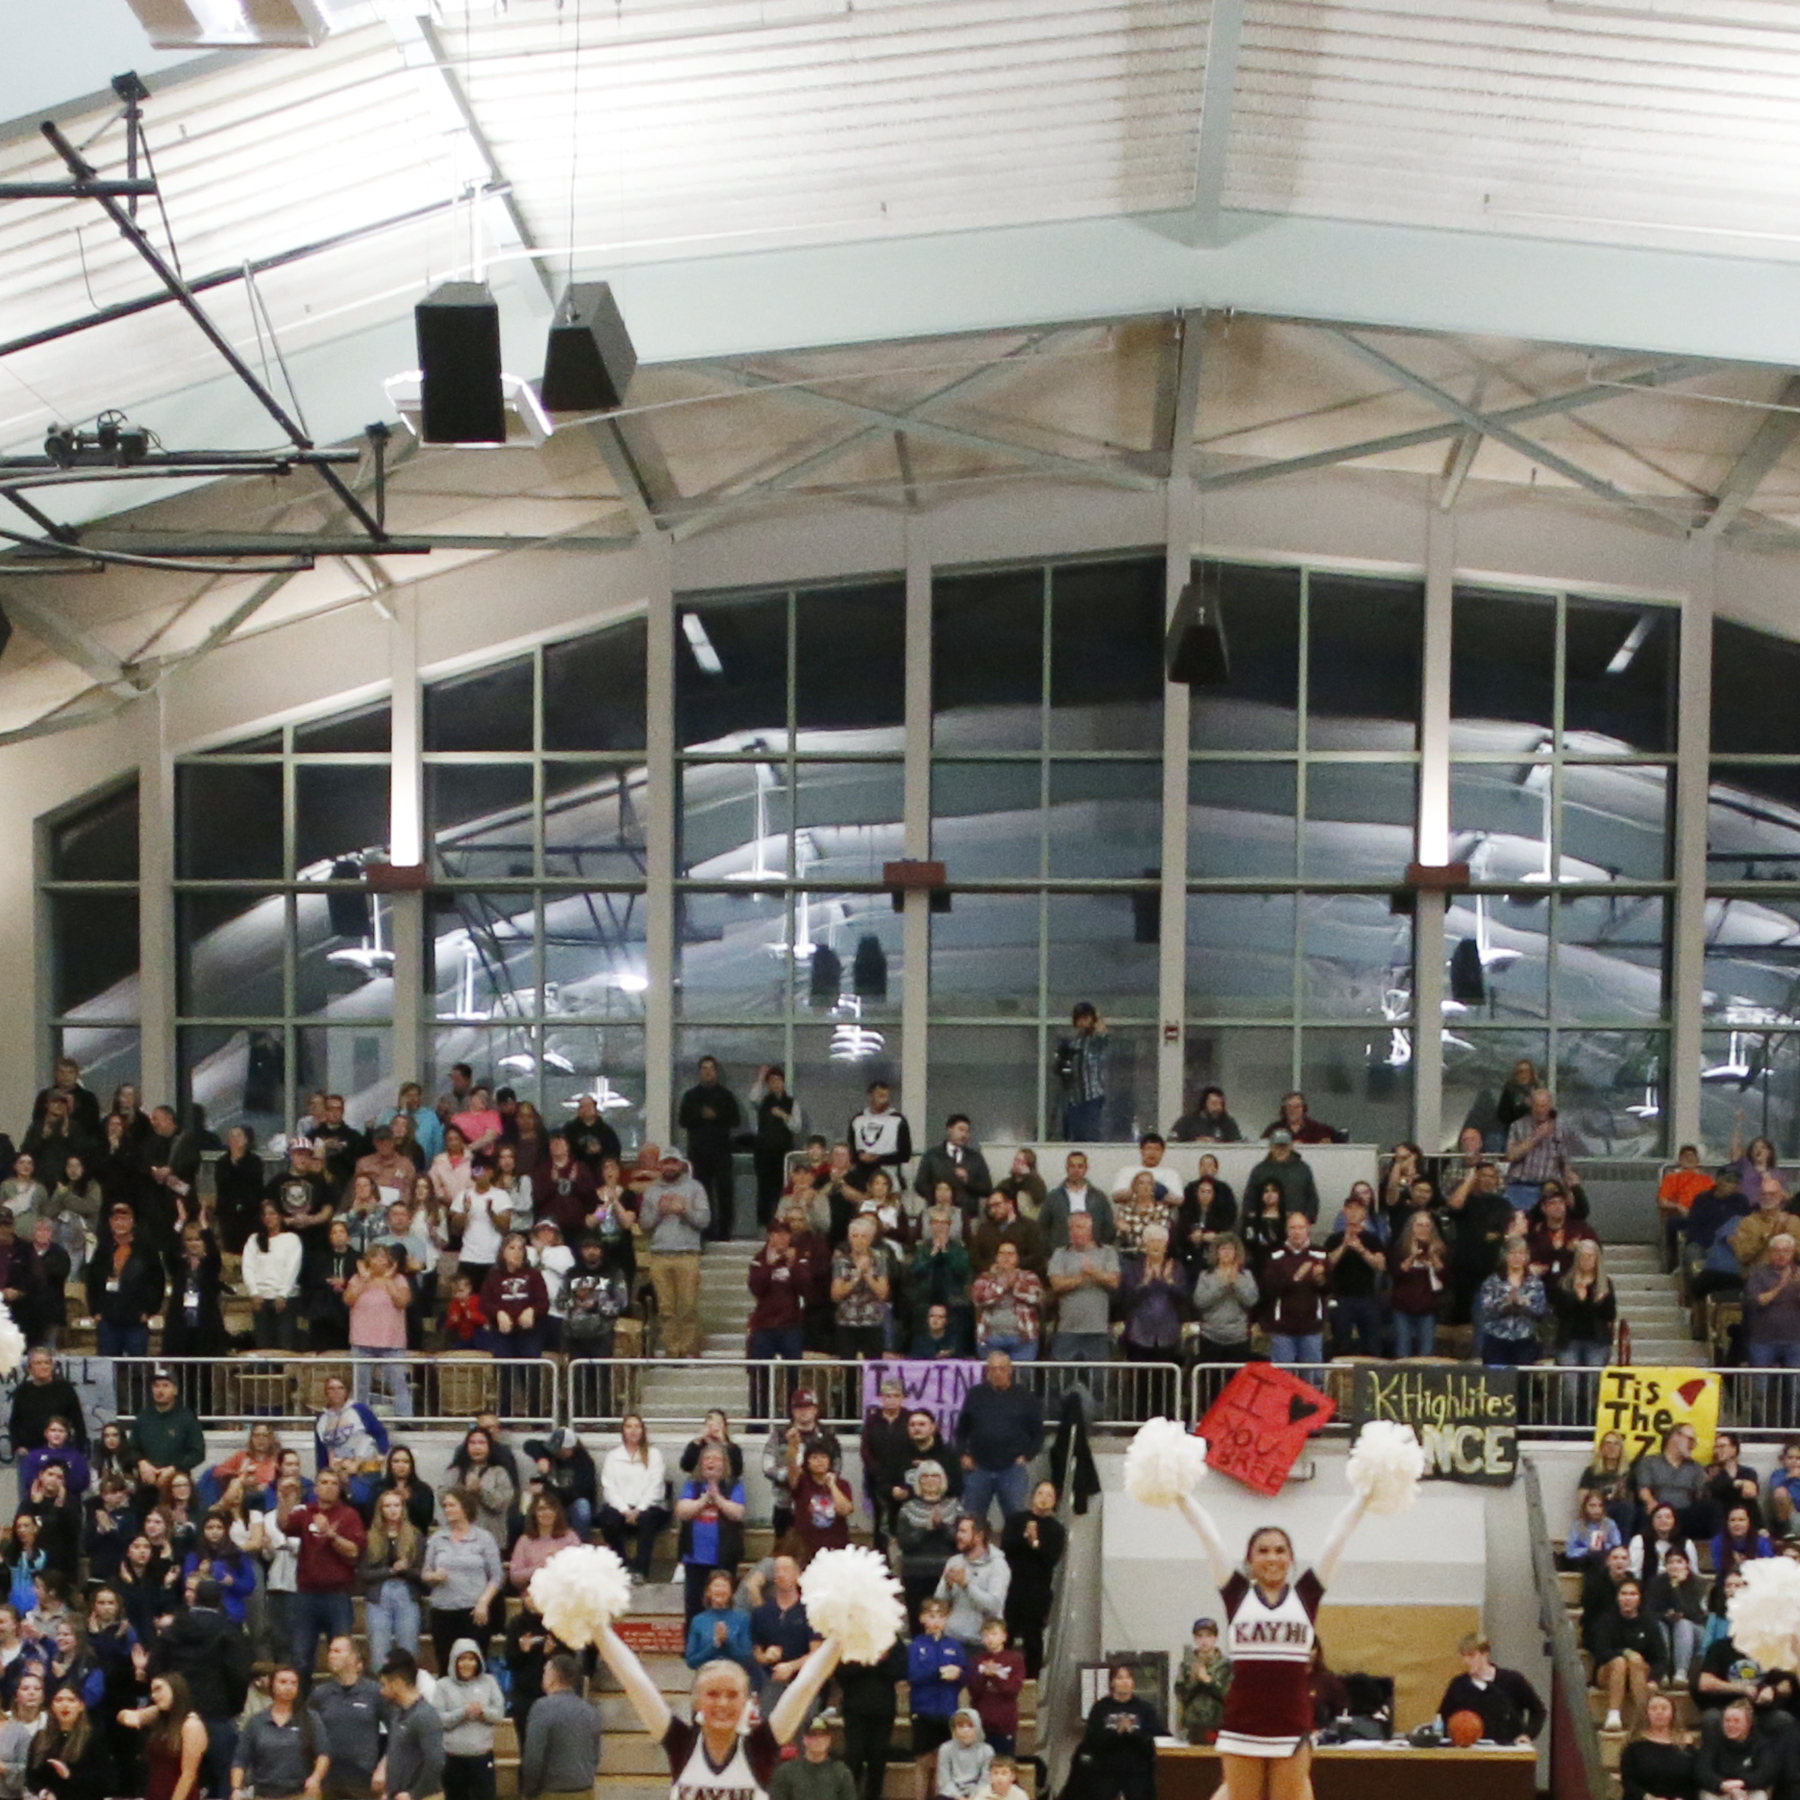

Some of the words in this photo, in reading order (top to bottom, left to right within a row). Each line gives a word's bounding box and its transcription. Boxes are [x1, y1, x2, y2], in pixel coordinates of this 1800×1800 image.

[1606, 1372, 1661, 1405] Tis
[1603, 1401, 1673, 1435] The
[1421, 1423, 1517, 1476] NCE
[1234, 1621, 1307, 1645] KAYHI
